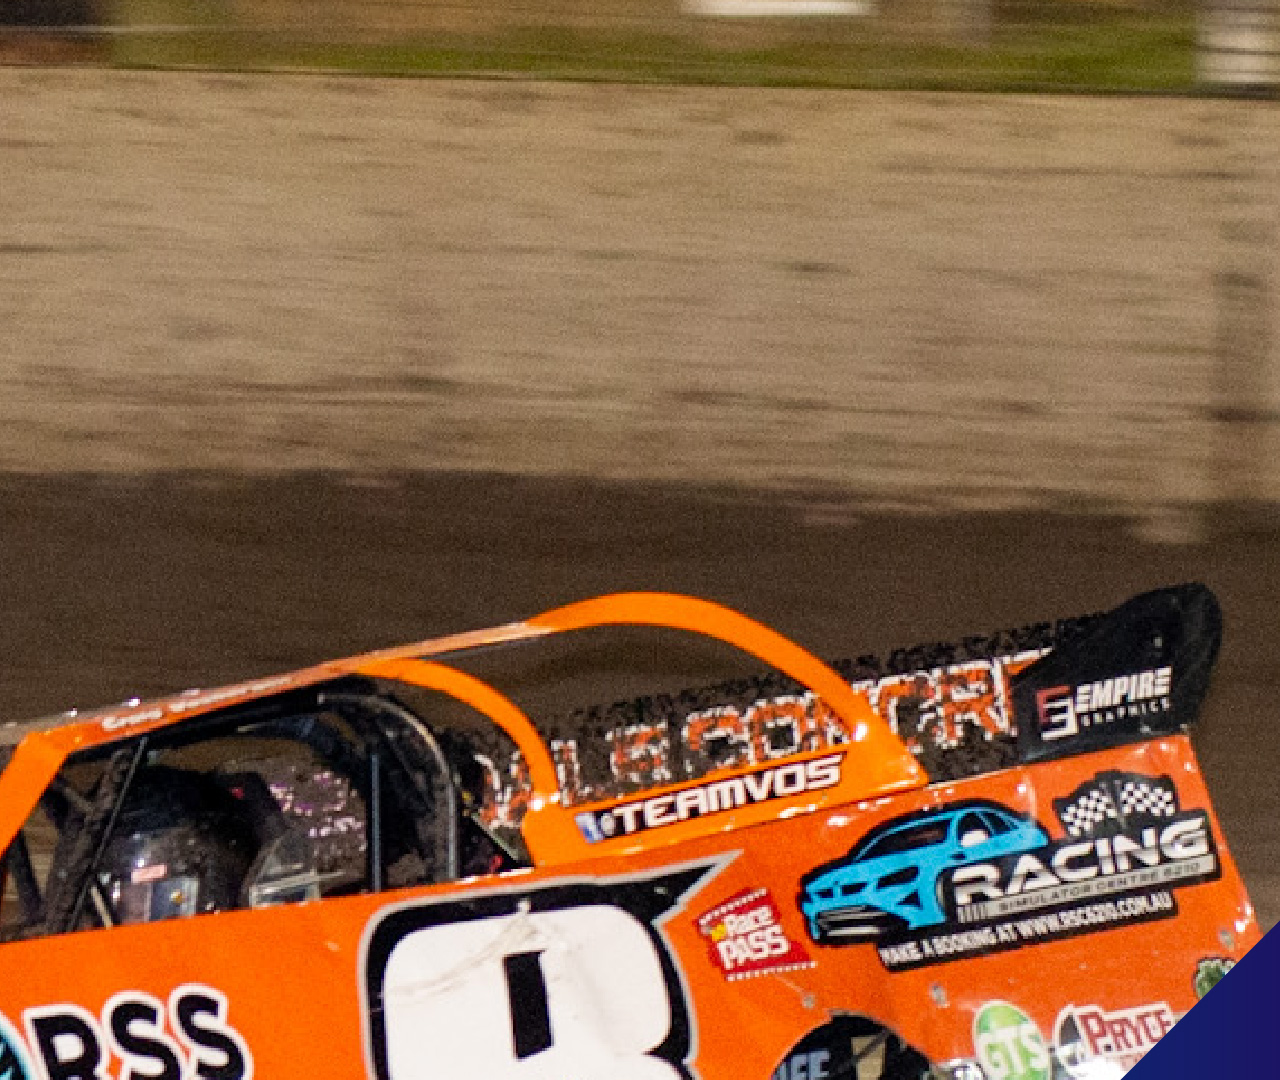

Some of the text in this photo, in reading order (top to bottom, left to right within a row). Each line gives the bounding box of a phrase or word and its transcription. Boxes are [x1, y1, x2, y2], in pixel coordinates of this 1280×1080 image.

[1075, 665, 1172, 713] EMPIRE
[1080, 697, 1172, 728] GRAPHICS
[612, 754, 843, 836] TEAMVOS
[952, 817, 1210, 905] RACING
[998, 885, 1094, 912] SIMULATOR
[1095, 870, 1158, 893] CENTRE
[724, 905, 776, 938] Race
[932, 926, 997, 956] BOOKING
[996, 922, 1018, 943] AT
[717, 924, 789, 971] PASS
[979, 1022, 1049, 1079] GTS
